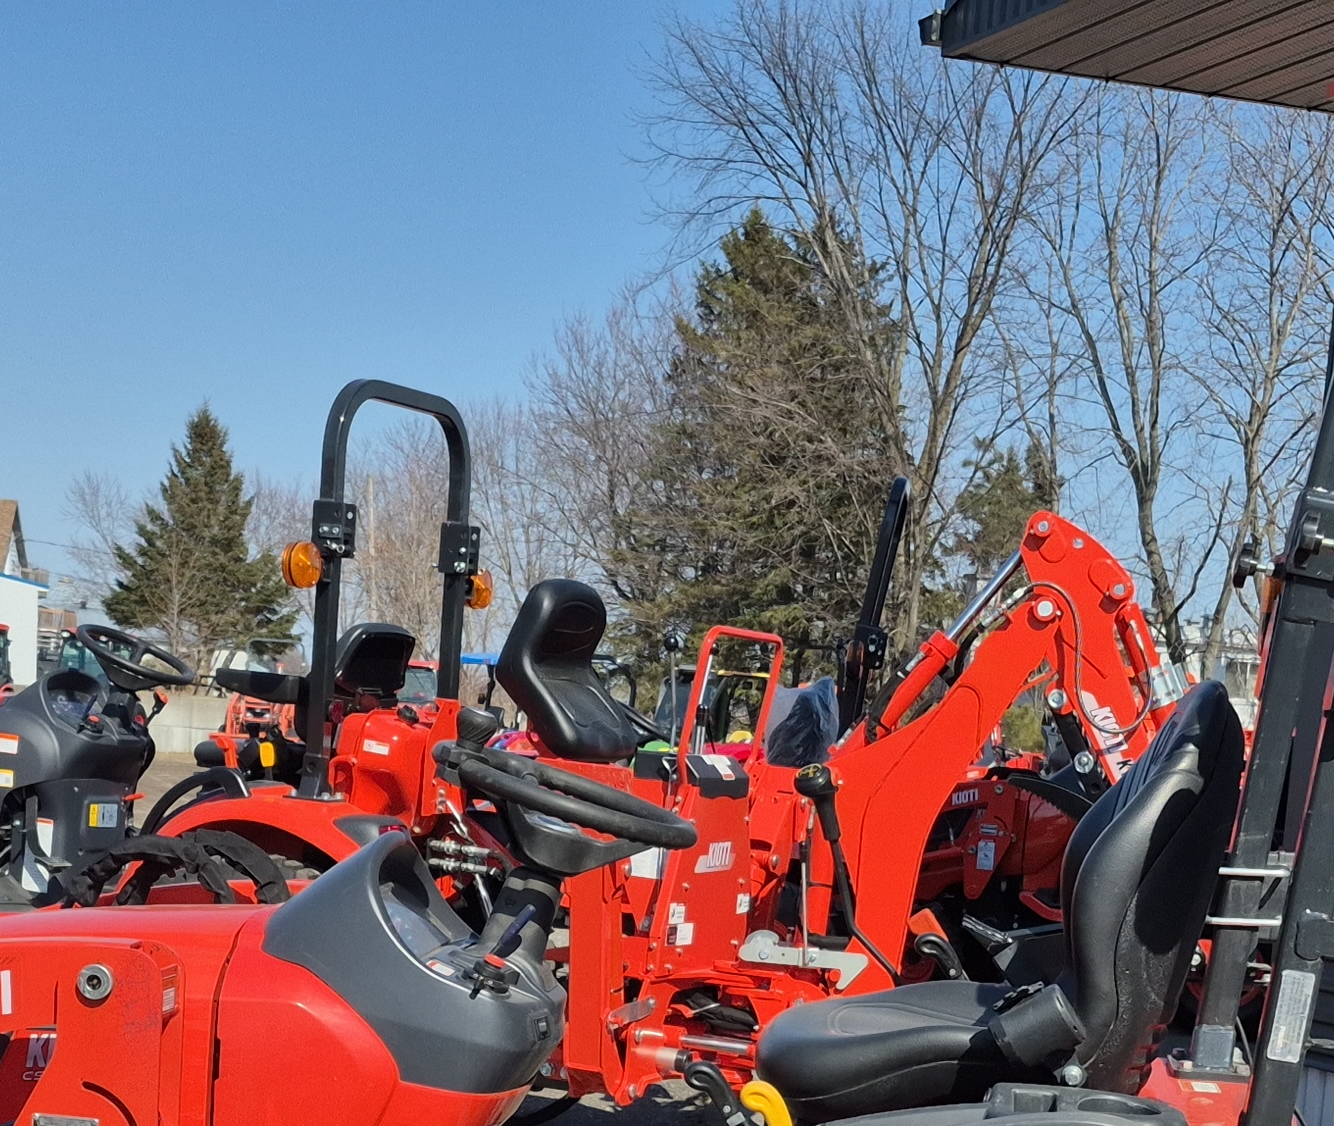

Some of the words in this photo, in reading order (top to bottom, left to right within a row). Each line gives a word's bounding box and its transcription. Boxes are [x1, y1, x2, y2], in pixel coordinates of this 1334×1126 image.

[951, 788, 979, 806] KIOTI
[706, 841, 732, 868] KIOTI
[26, 1033, 57, 1068] KI
